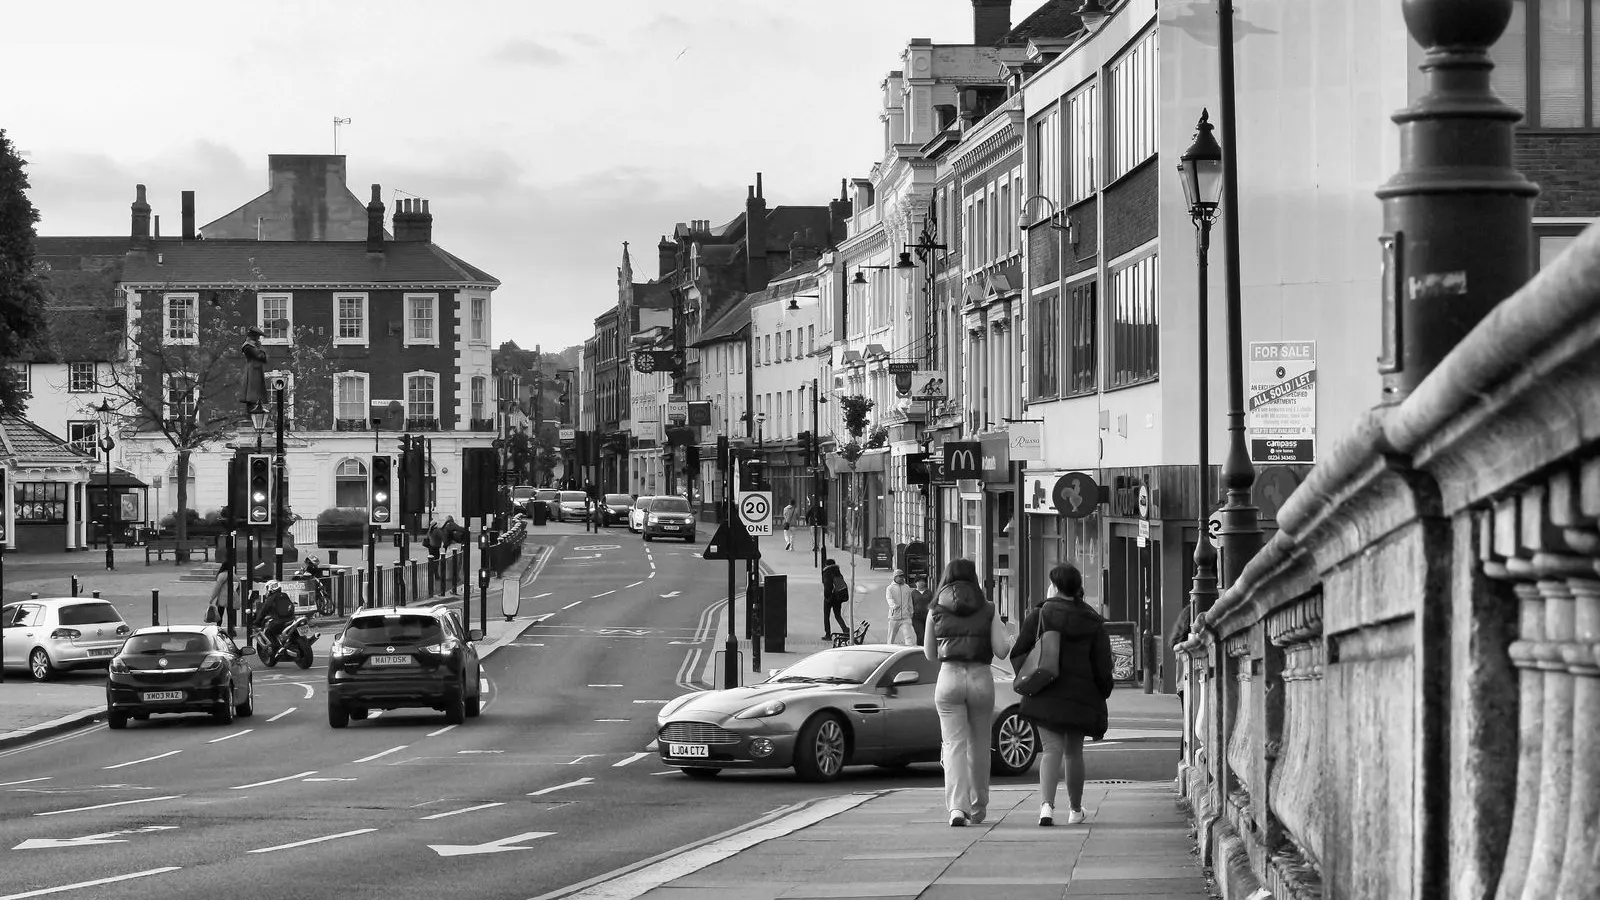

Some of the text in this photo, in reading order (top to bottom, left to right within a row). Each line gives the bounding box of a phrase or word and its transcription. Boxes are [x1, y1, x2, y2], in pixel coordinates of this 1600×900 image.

[1255, 345, 1310, 358] FOR SALE
[1254, 393, 1270, 407] ALL
[745, 502, 766, 514] 20
[746, 524, 769, 533] ONE
[165, 691, 180, 699] RAZ
[690, 746, 705, 756] CTZ
